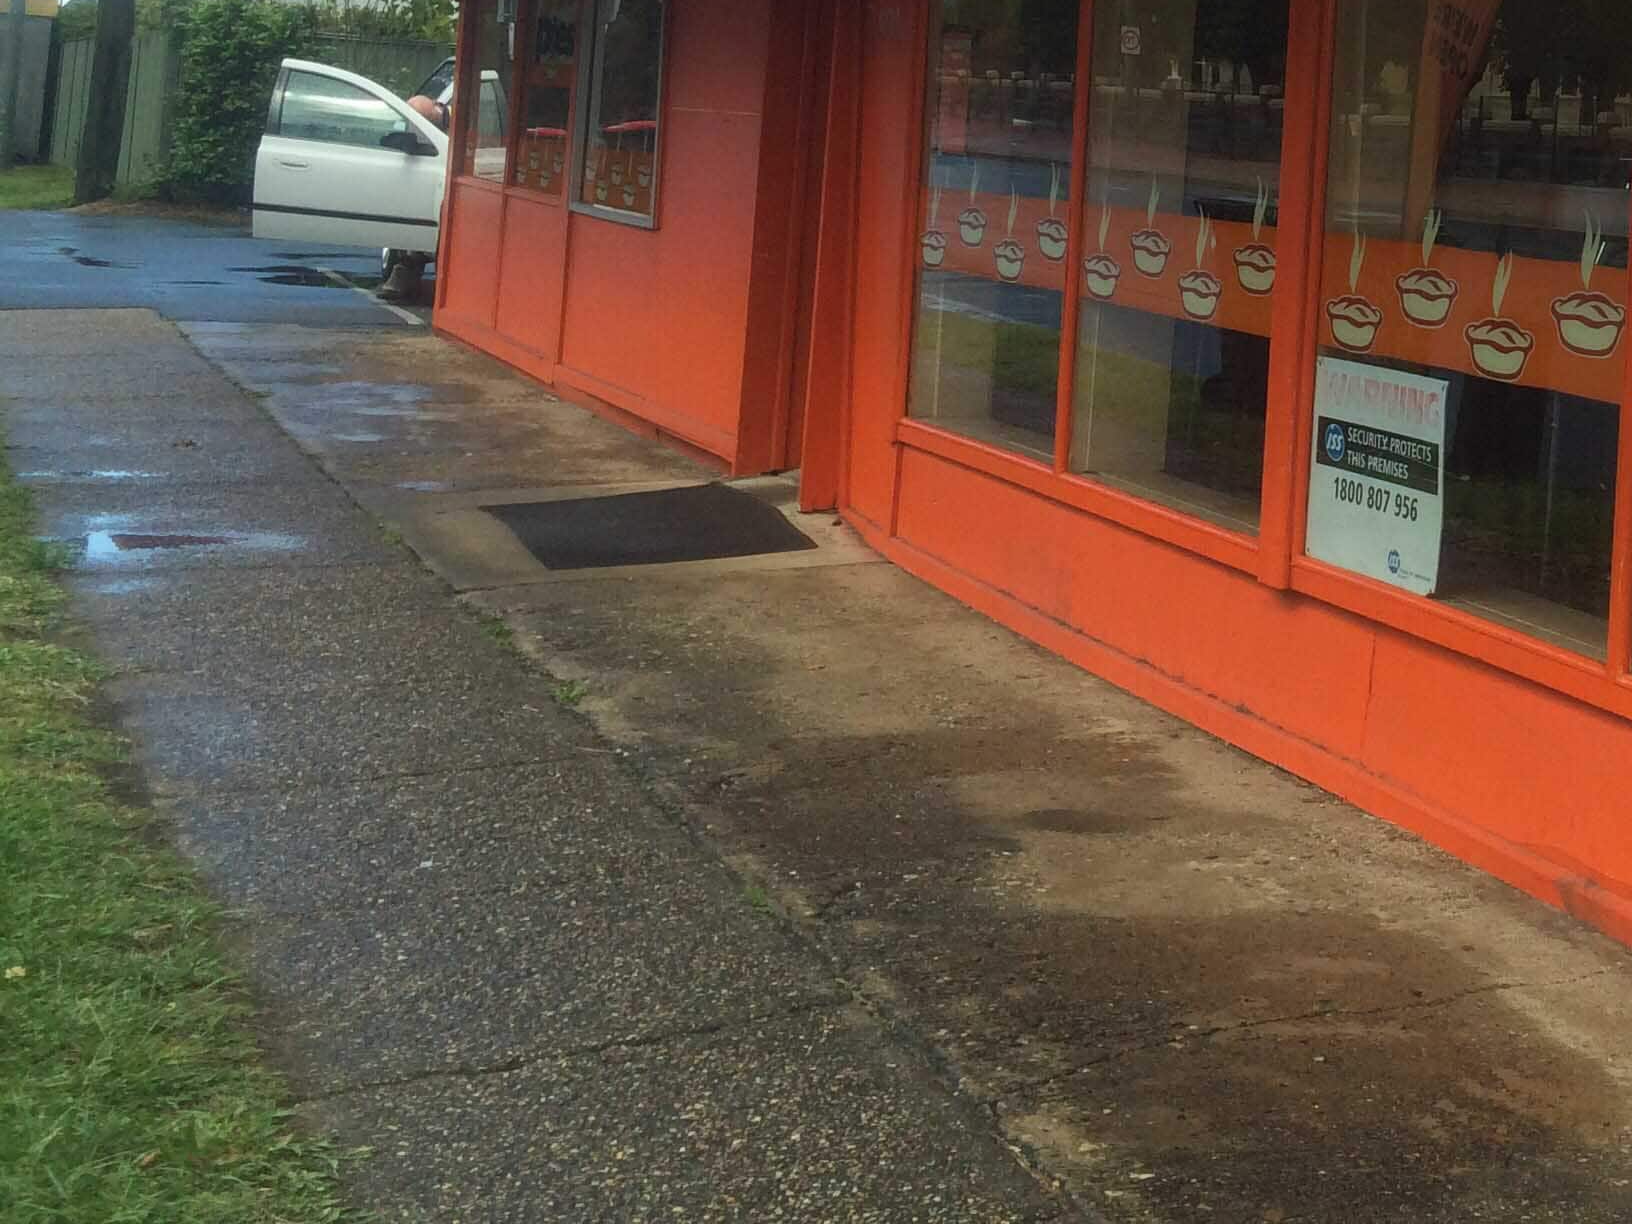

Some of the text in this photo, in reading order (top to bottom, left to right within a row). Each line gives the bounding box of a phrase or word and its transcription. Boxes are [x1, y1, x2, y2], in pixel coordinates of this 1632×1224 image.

[1326, 432, 1344, 452] ISS
[1347, 427, 1432, 462] SECURITY PROTECTS
[1347, 451, 1408, 480] THIS PREMISES
[1334, 477, 1418, 521] 1800 807 956
